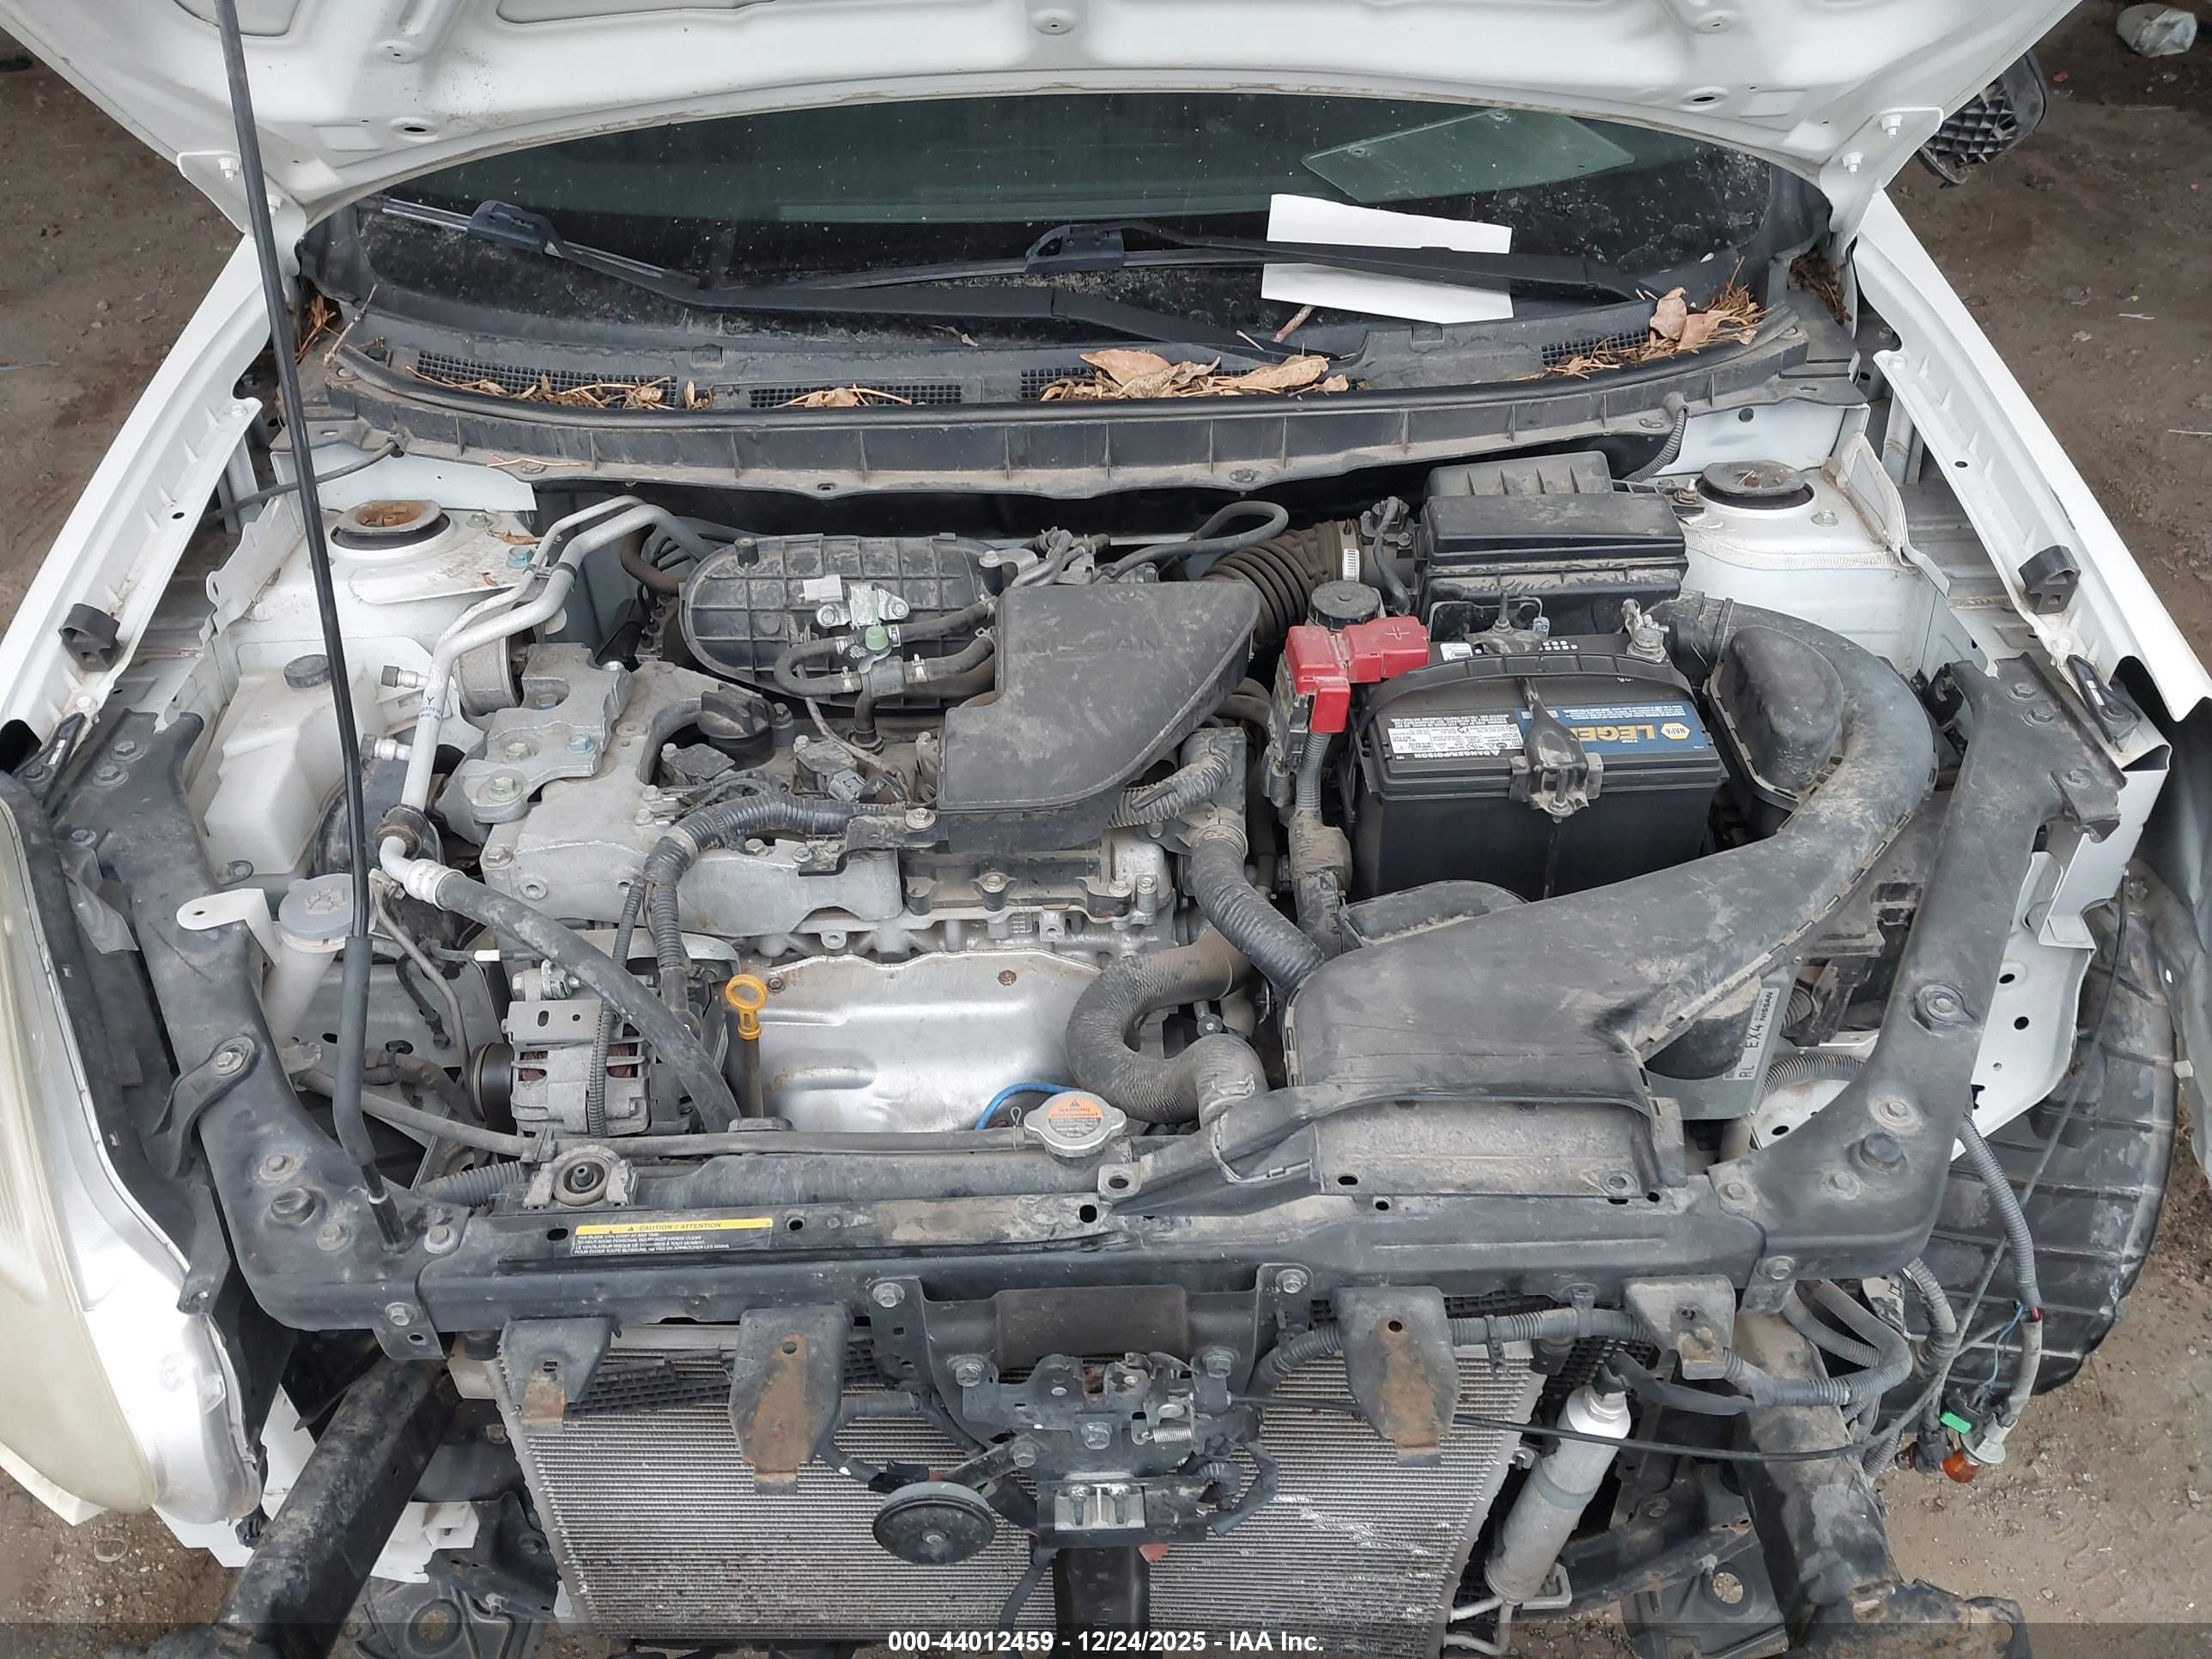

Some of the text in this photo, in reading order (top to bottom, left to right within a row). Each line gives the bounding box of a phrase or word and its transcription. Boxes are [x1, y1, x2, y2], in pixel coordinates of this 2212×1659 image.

[1664, 726, 1686, 735] NAPA
[1759, 992, 1773, 1021] NISSAN
[1745, 1024, 1764, 1048] EX4
[1739, 1065, 1754, 1078] RL
